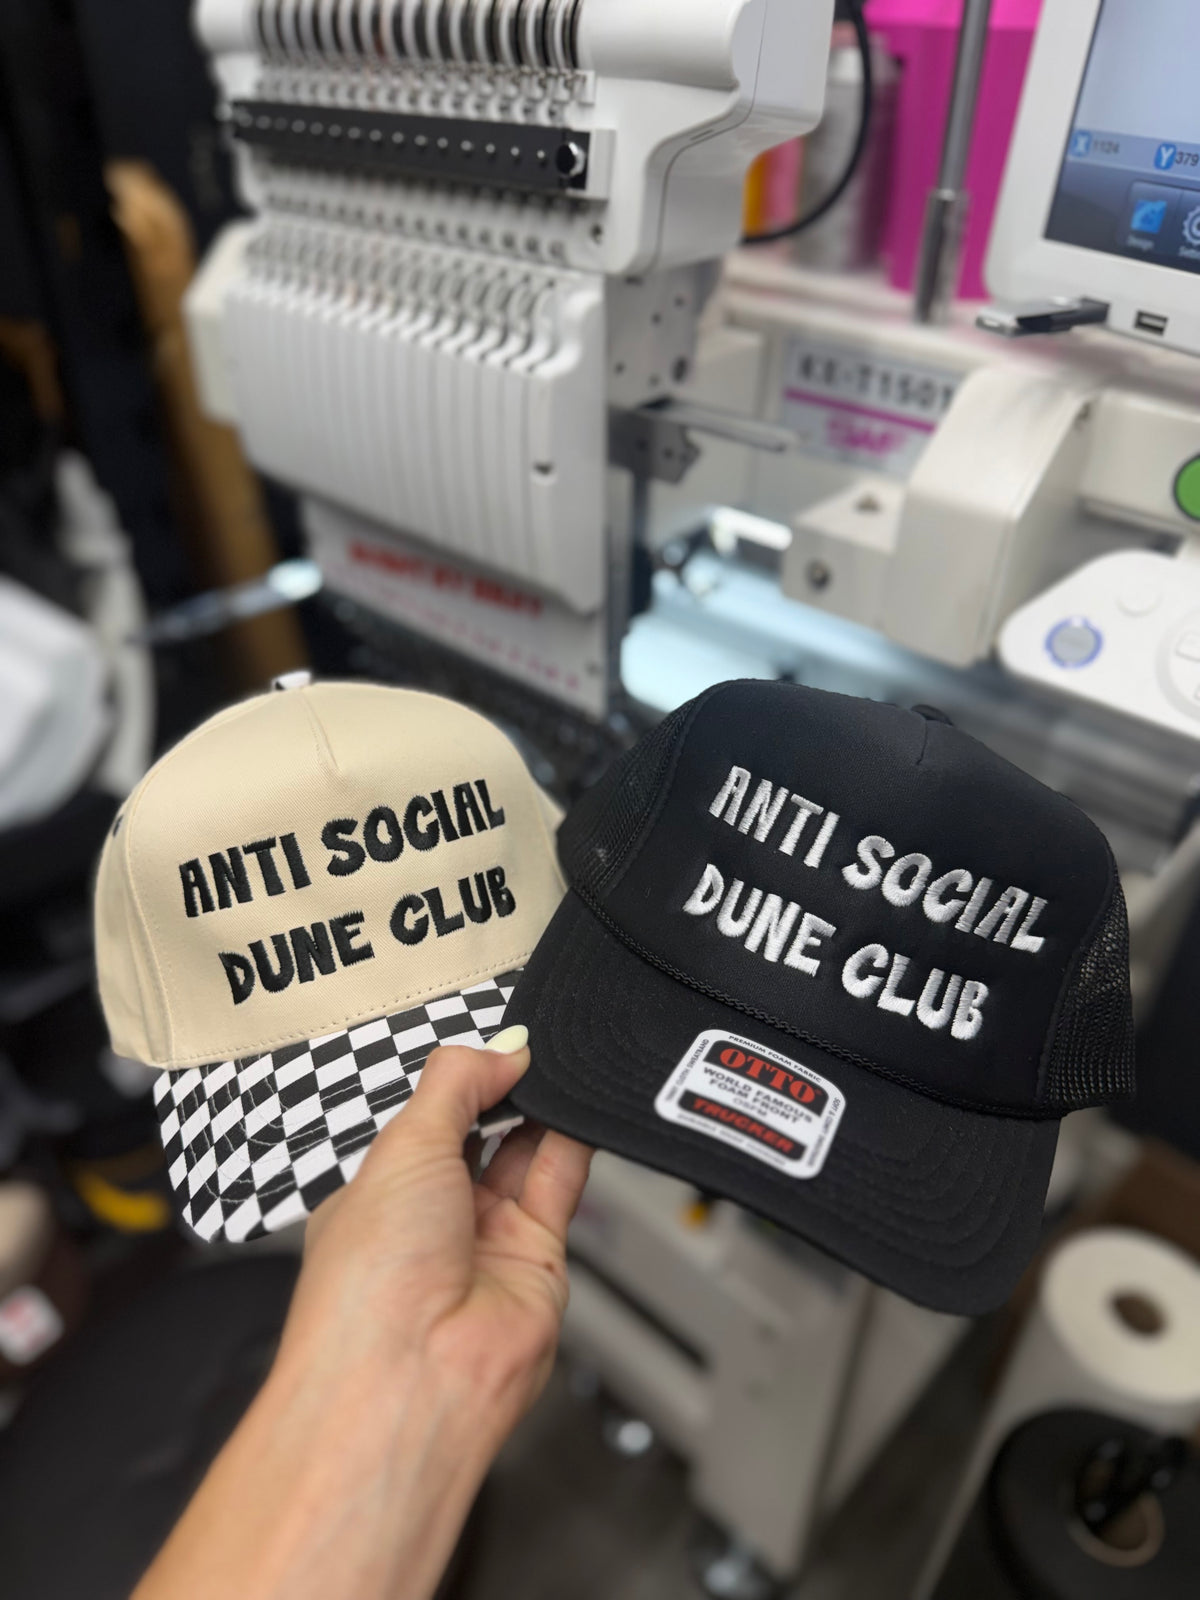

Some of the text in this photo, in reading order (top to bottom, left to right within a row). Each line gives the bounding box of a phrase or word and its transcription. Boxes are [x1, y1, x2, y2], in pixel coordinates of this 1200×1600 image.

[179, 779, 506, 918] ANTI SOCIAL
[708, 765, 1048, 954] ANTI SOCIAL
[218, 865, 516, 1006] DUNE CLUB
[682, 863, 989, 1040] DUNE CLUB
[687, 1038, 710, 1069] SWEATBAND
[720, 1048, 815, 1104] OTTO
[729, 1035, 822, 1083] PREMIUM FOAM FABRIC
[703, 1066, 813, 1123] WORLD FAMOUS
[709, 1079, 799, 1124] FOAM FRONT
[831, 1097, 841, 1112] SOFT
[693, 1097, 794, 1154] TRUCKER
